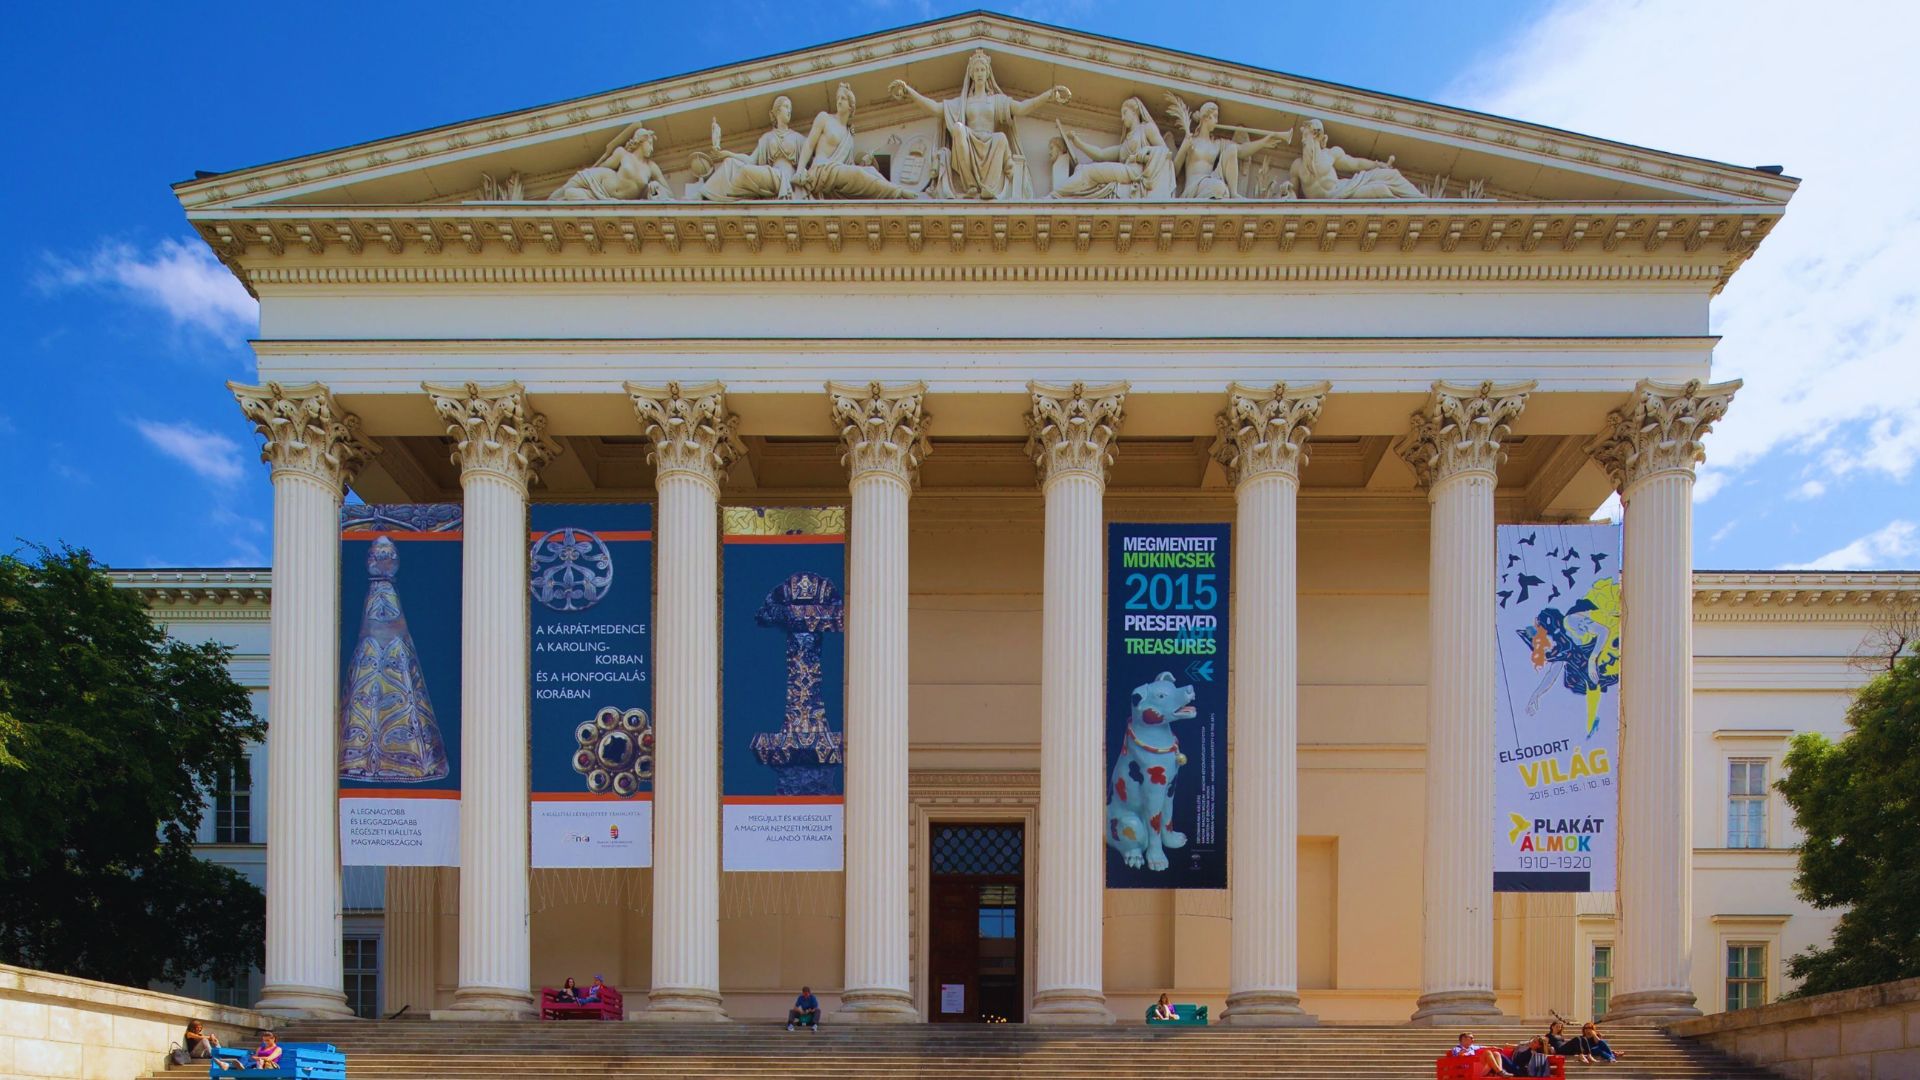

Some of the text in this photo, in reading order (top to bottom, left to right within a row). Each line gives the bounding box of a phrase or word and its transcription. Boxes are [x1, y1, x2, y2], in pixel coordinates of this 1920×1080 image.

[1124, 537, 1218, 551] MEGMENTETT
[1125, 573, 1218, 610] 2015
[536, 622, 646, 634] A KÁRPÁT-MEDENCE
[1124, 615, 1217, 631] PRESERVED
[536, 642, 610, 652] A KAROLING-
[1124, 638, 1216, 654] TREASURES
[595, 654, 643, 664] KORBAN
[536, 670, 646, 682] ÉS A HONFOGLALÁS
[536, 687, 590, 699] KORÁBAN
[1500, 739, 1569, 763] ELSODORT
[1518, 746, 1610, 788] VILÁG
[1534, 815, 1604, 833] PLAKÁT
[1520, 832, 1591, 852] ÁLMOK
